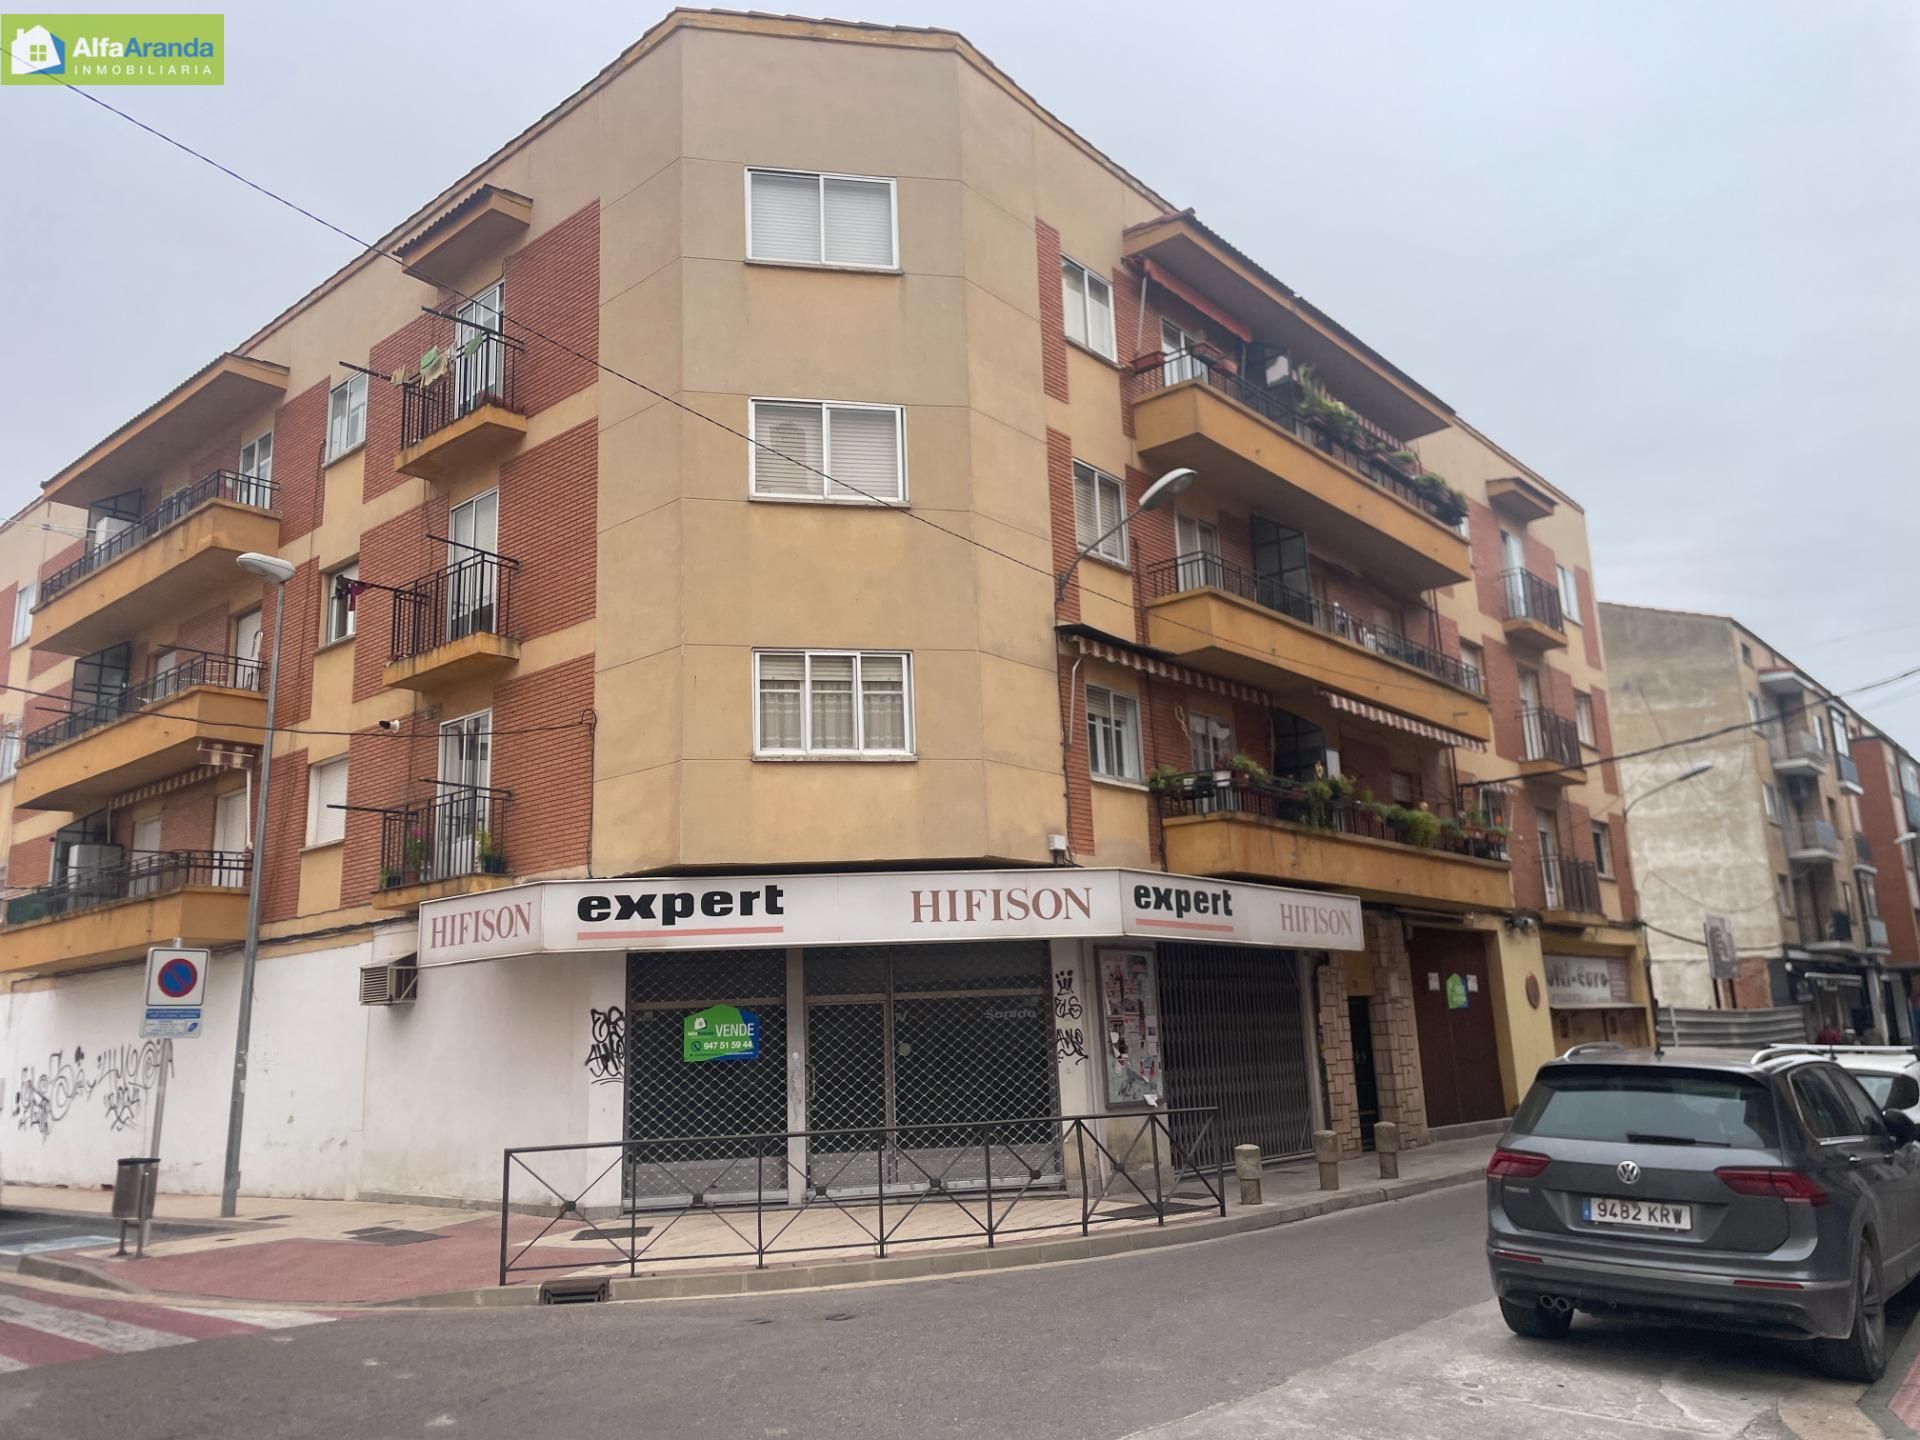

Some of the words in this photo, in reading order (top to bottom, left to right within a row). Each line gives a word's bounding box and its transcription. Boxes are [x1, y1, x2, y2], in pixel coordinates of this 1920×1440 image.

[577, 885, 784, 926] expert
[910, 887, 1092, 923] HIFISON
[1134, 884, 1232, 918] expert
[430, 902, 532, 949] HIFISON
[1280, 903, 1353, 936] HIFISON
[715, 1023, 754, 1037] VENDE
[731, 1041, 741, 1049] 59
[1597, 1202, 1642, 1221] 9482
[1648, 1206, 1683, 1225] KRW
